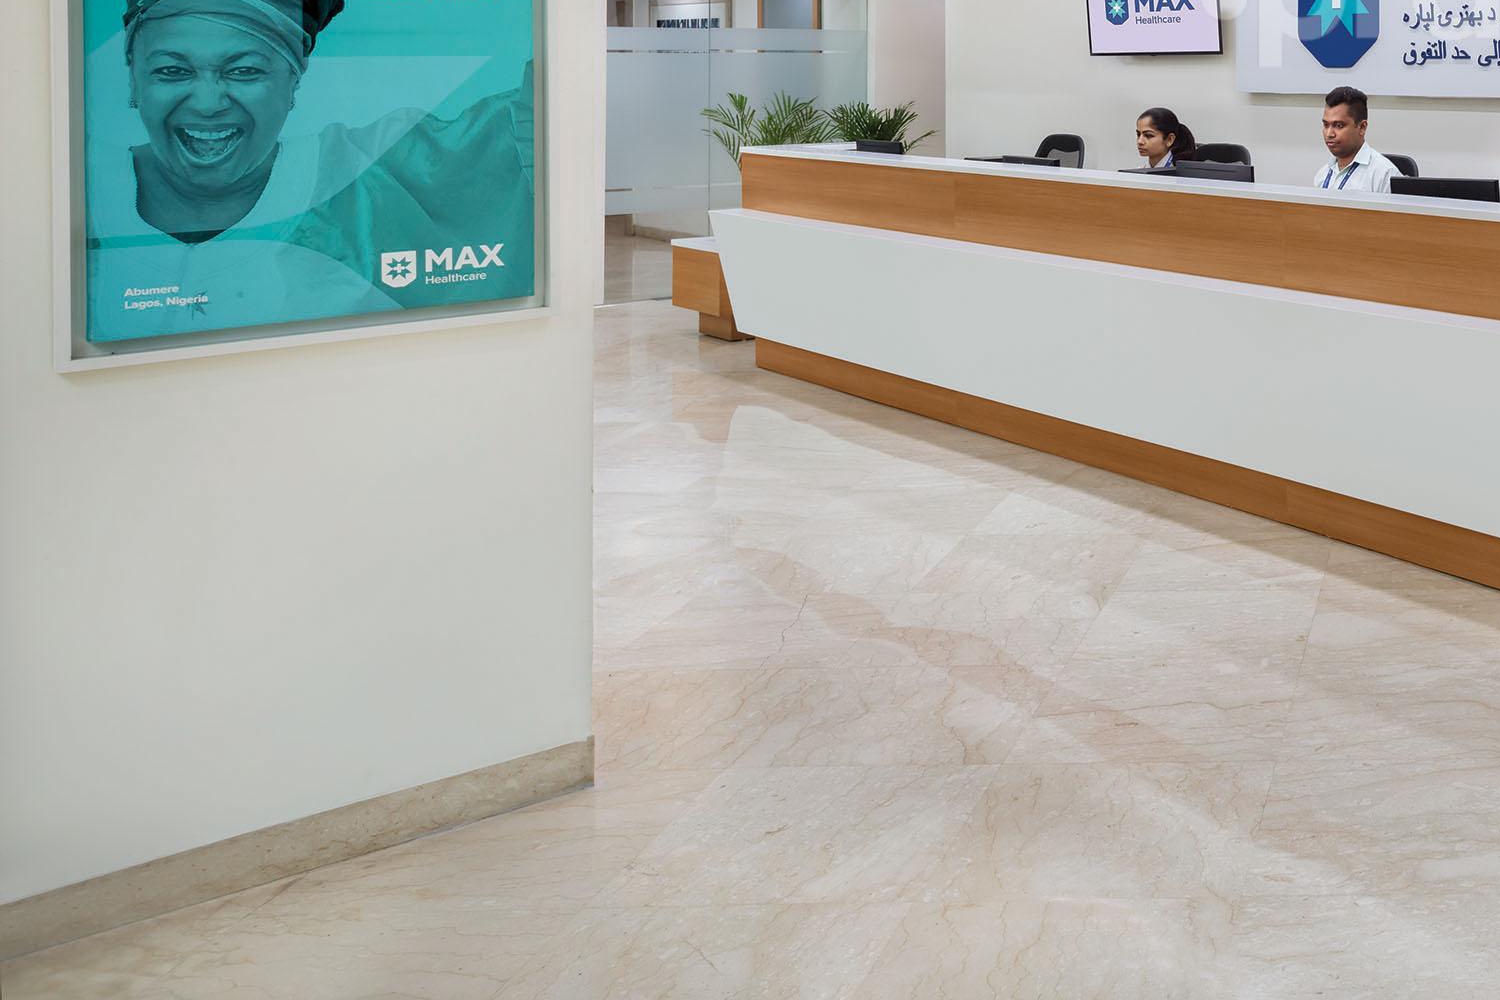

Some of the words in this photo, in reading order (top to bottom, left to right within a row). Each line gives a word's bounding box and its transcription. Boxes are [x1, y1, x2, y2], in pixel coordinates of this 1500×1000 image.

[1135, 15, 1181, 24] Healthcare
[1451, 46, 1471, 59] حد
[425, 243, 505, 273] MAX
[425, 272, 487, 285] Healthcare
[124, 286, 179, 297] Abumere
[166, 295, 208, 306] Nigeria
